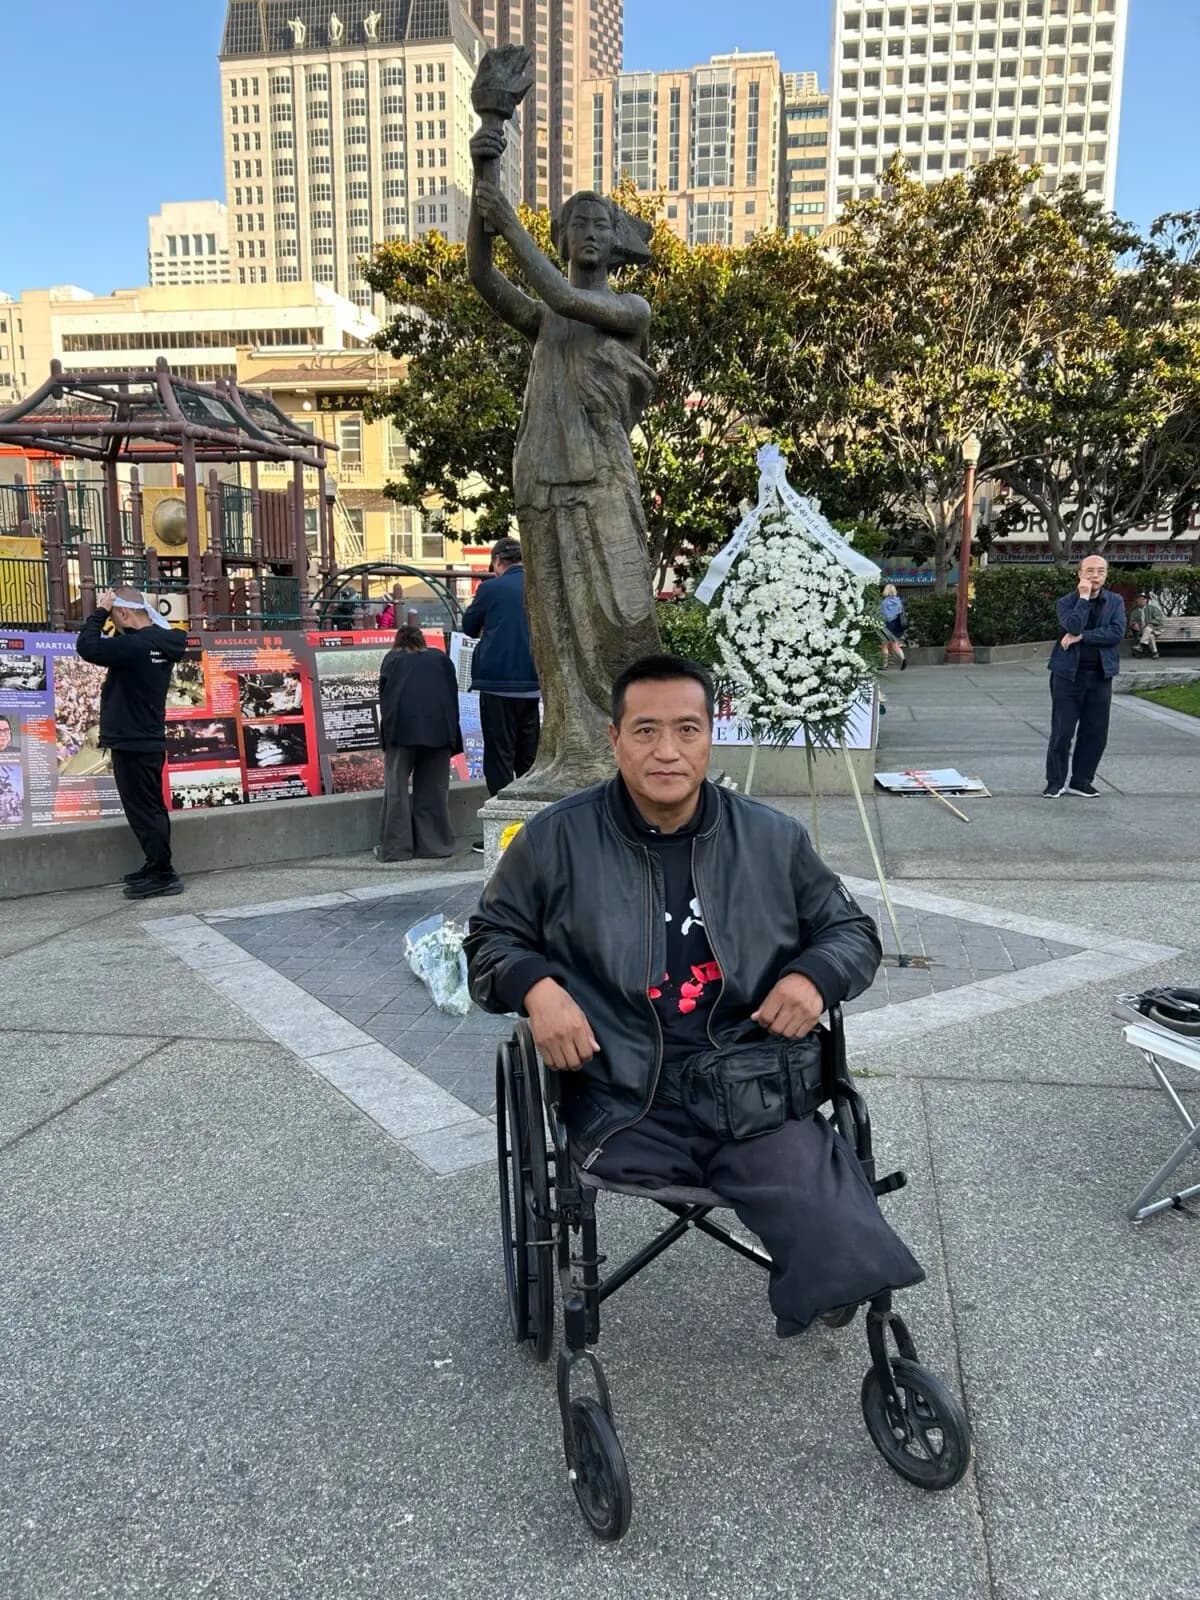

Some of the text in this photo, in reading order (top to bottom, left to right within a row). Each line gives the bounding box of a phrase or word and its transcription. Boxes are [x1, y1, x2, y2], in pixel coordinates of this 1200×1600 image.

[214, 638, 258, 646] MASSACRE
[361, 635, 395, 645] AFTERMA
[36, 641, 76, 650] MARTIAL
